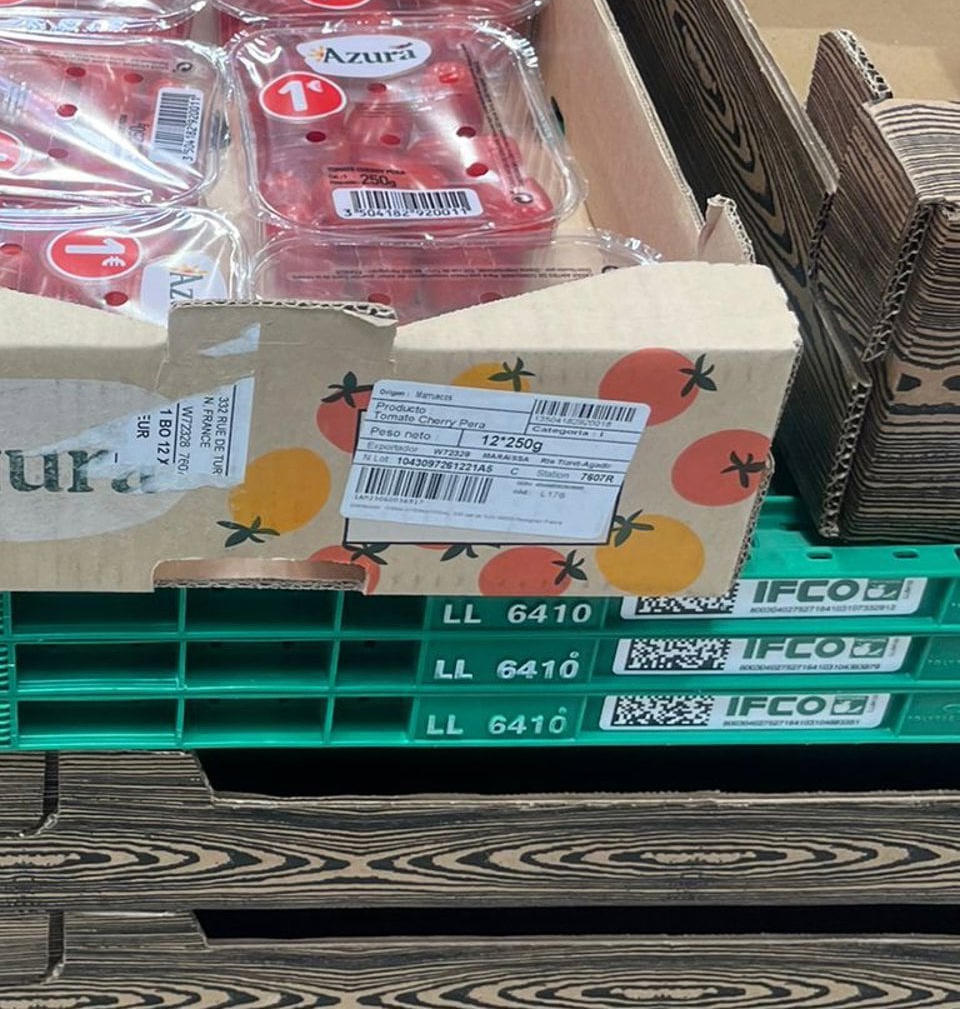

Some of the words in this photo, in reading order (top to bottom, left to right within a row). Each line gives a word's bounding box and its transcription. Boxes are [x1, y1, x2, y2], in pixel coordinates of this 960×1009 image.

[324, 47, 416, 64] Azura
[360, 174, 397, 188] 250g
[218, 396, 229, 413] 332
[376, 402, 426, 414] Producto
[159, 419, 172, 438] BO
[179, 406, 193, 448] W72328
[200, 409, 213, 448] FRANCE
[215, 416, 228, 436] RUE
[374, 411, 415, 422] Tomate
[418, 415, 457, 428] Cherry
[459, 419, 486, 429] Pera
[370, 426, 400, 438] Peso
[404, 430, 431, 441] neto
[157, 442, 170, 454] 12
[214, 438, 225, 452] DE
[367, 442, 419, 453] Exportador
[212, 454, 224, 475] TUR
[510, 467, 519, 475] C
[537, 469, 570, 479] Station
[581, 473, 614, 483] 7607R
[753, 579, 860, 603] IFCO
[443, 604, 481, 623] LL
[507, 603, 592, 623] 6410
[742, 638, 846, 659] IFCO
[434, 659, 473, 679] LL
[496, 659, 579, 679] 6410
[726, 696, 826, 716] IFCO
[426, 715, 463, 735] LL
[488, 714, 567, 735] 6410
